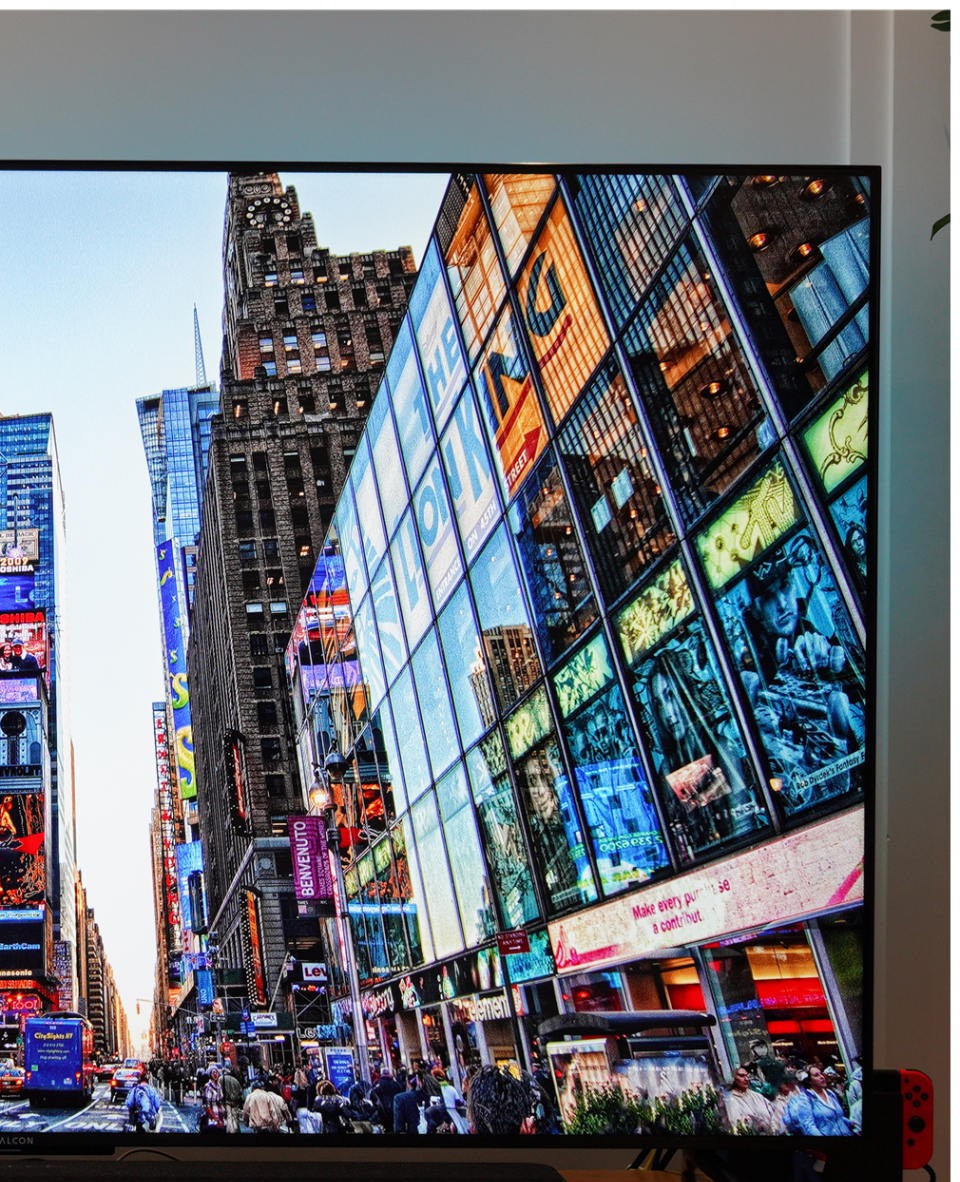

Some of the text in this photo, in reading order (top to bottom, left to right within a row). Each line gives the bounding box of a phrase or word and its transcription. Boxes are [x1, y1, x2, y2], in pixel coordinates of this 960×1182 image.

[505, 450, 529, 490] STREET
[0, 556, 28, 566] 2009
[293, 821, 315, 897] BENVENUTO
[633, 893, 683, 919] Make every
[652, 922, 660, 935] a
